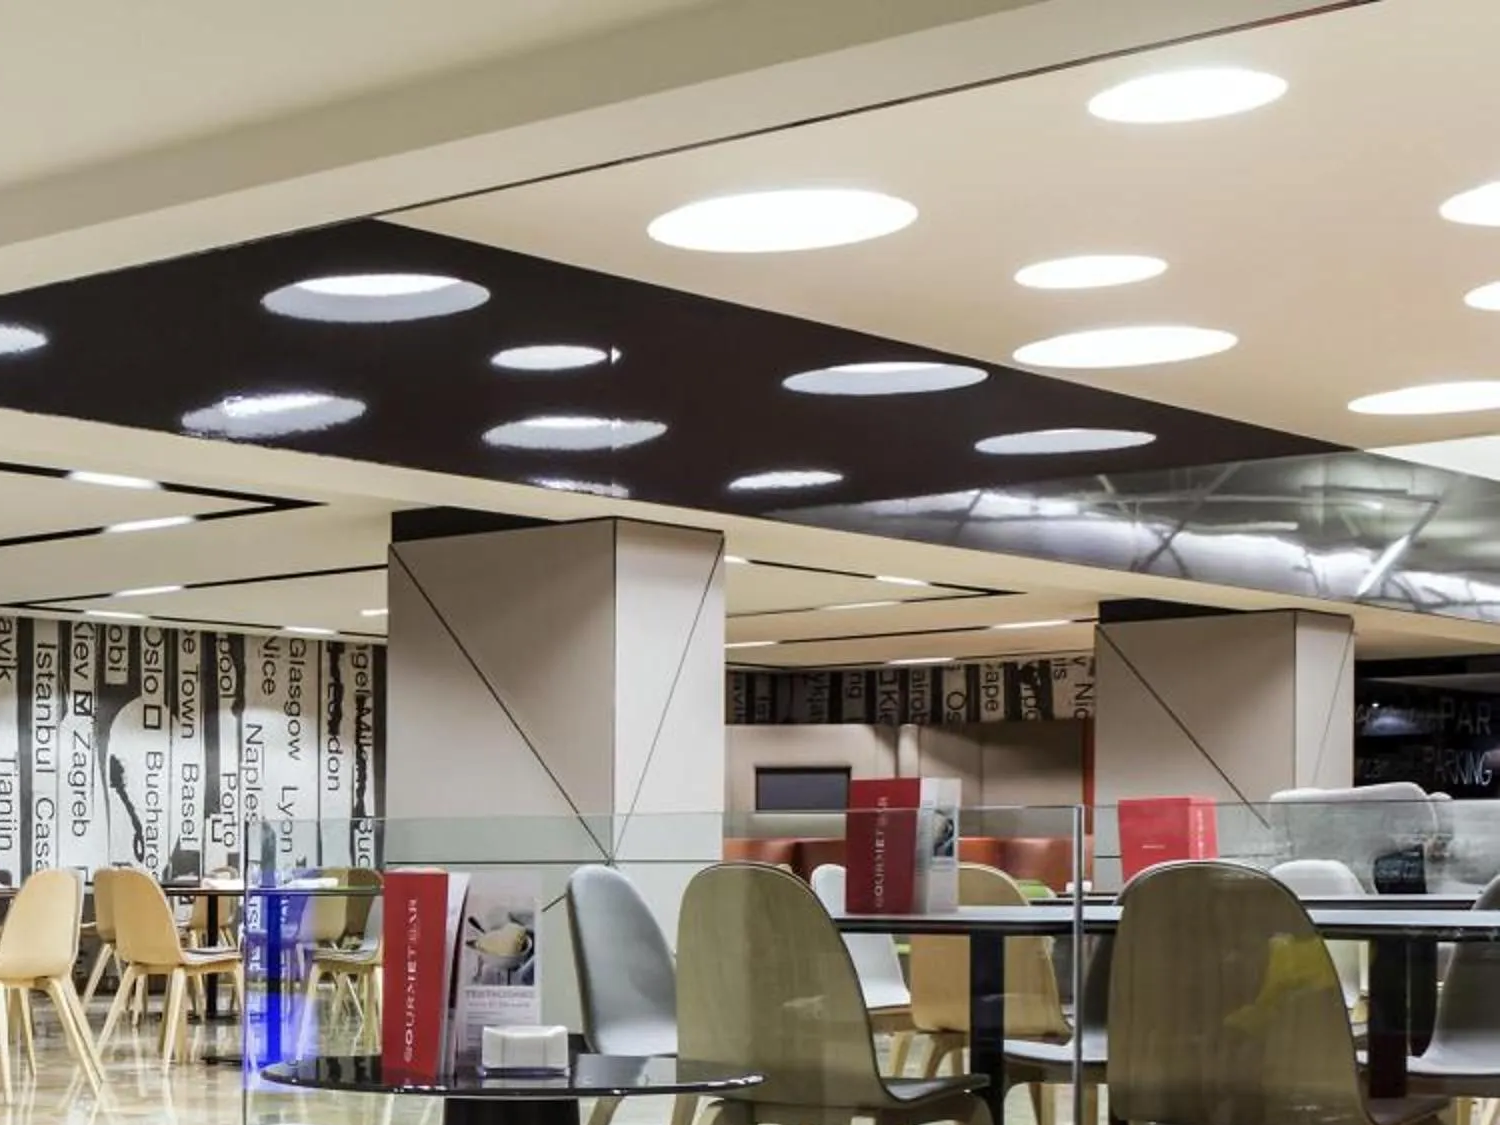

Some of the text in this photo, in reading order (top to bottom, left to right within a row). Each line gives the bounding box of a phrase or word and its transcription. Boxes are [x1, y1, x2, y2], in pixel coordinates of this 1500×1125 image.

[143, 626, 164, 694] Oslo
[180, 664, 200, 739] Town
[34, 642, 58, 773] Istanbul
[276, 637, 308, 854] Glasgow Lyon
[67, 730, 91, 837] Zagreb
[180, 763, 200, 844] Basel
[220, 772, 238, 848] Porto
[241, 723, 265, 823] Naples
